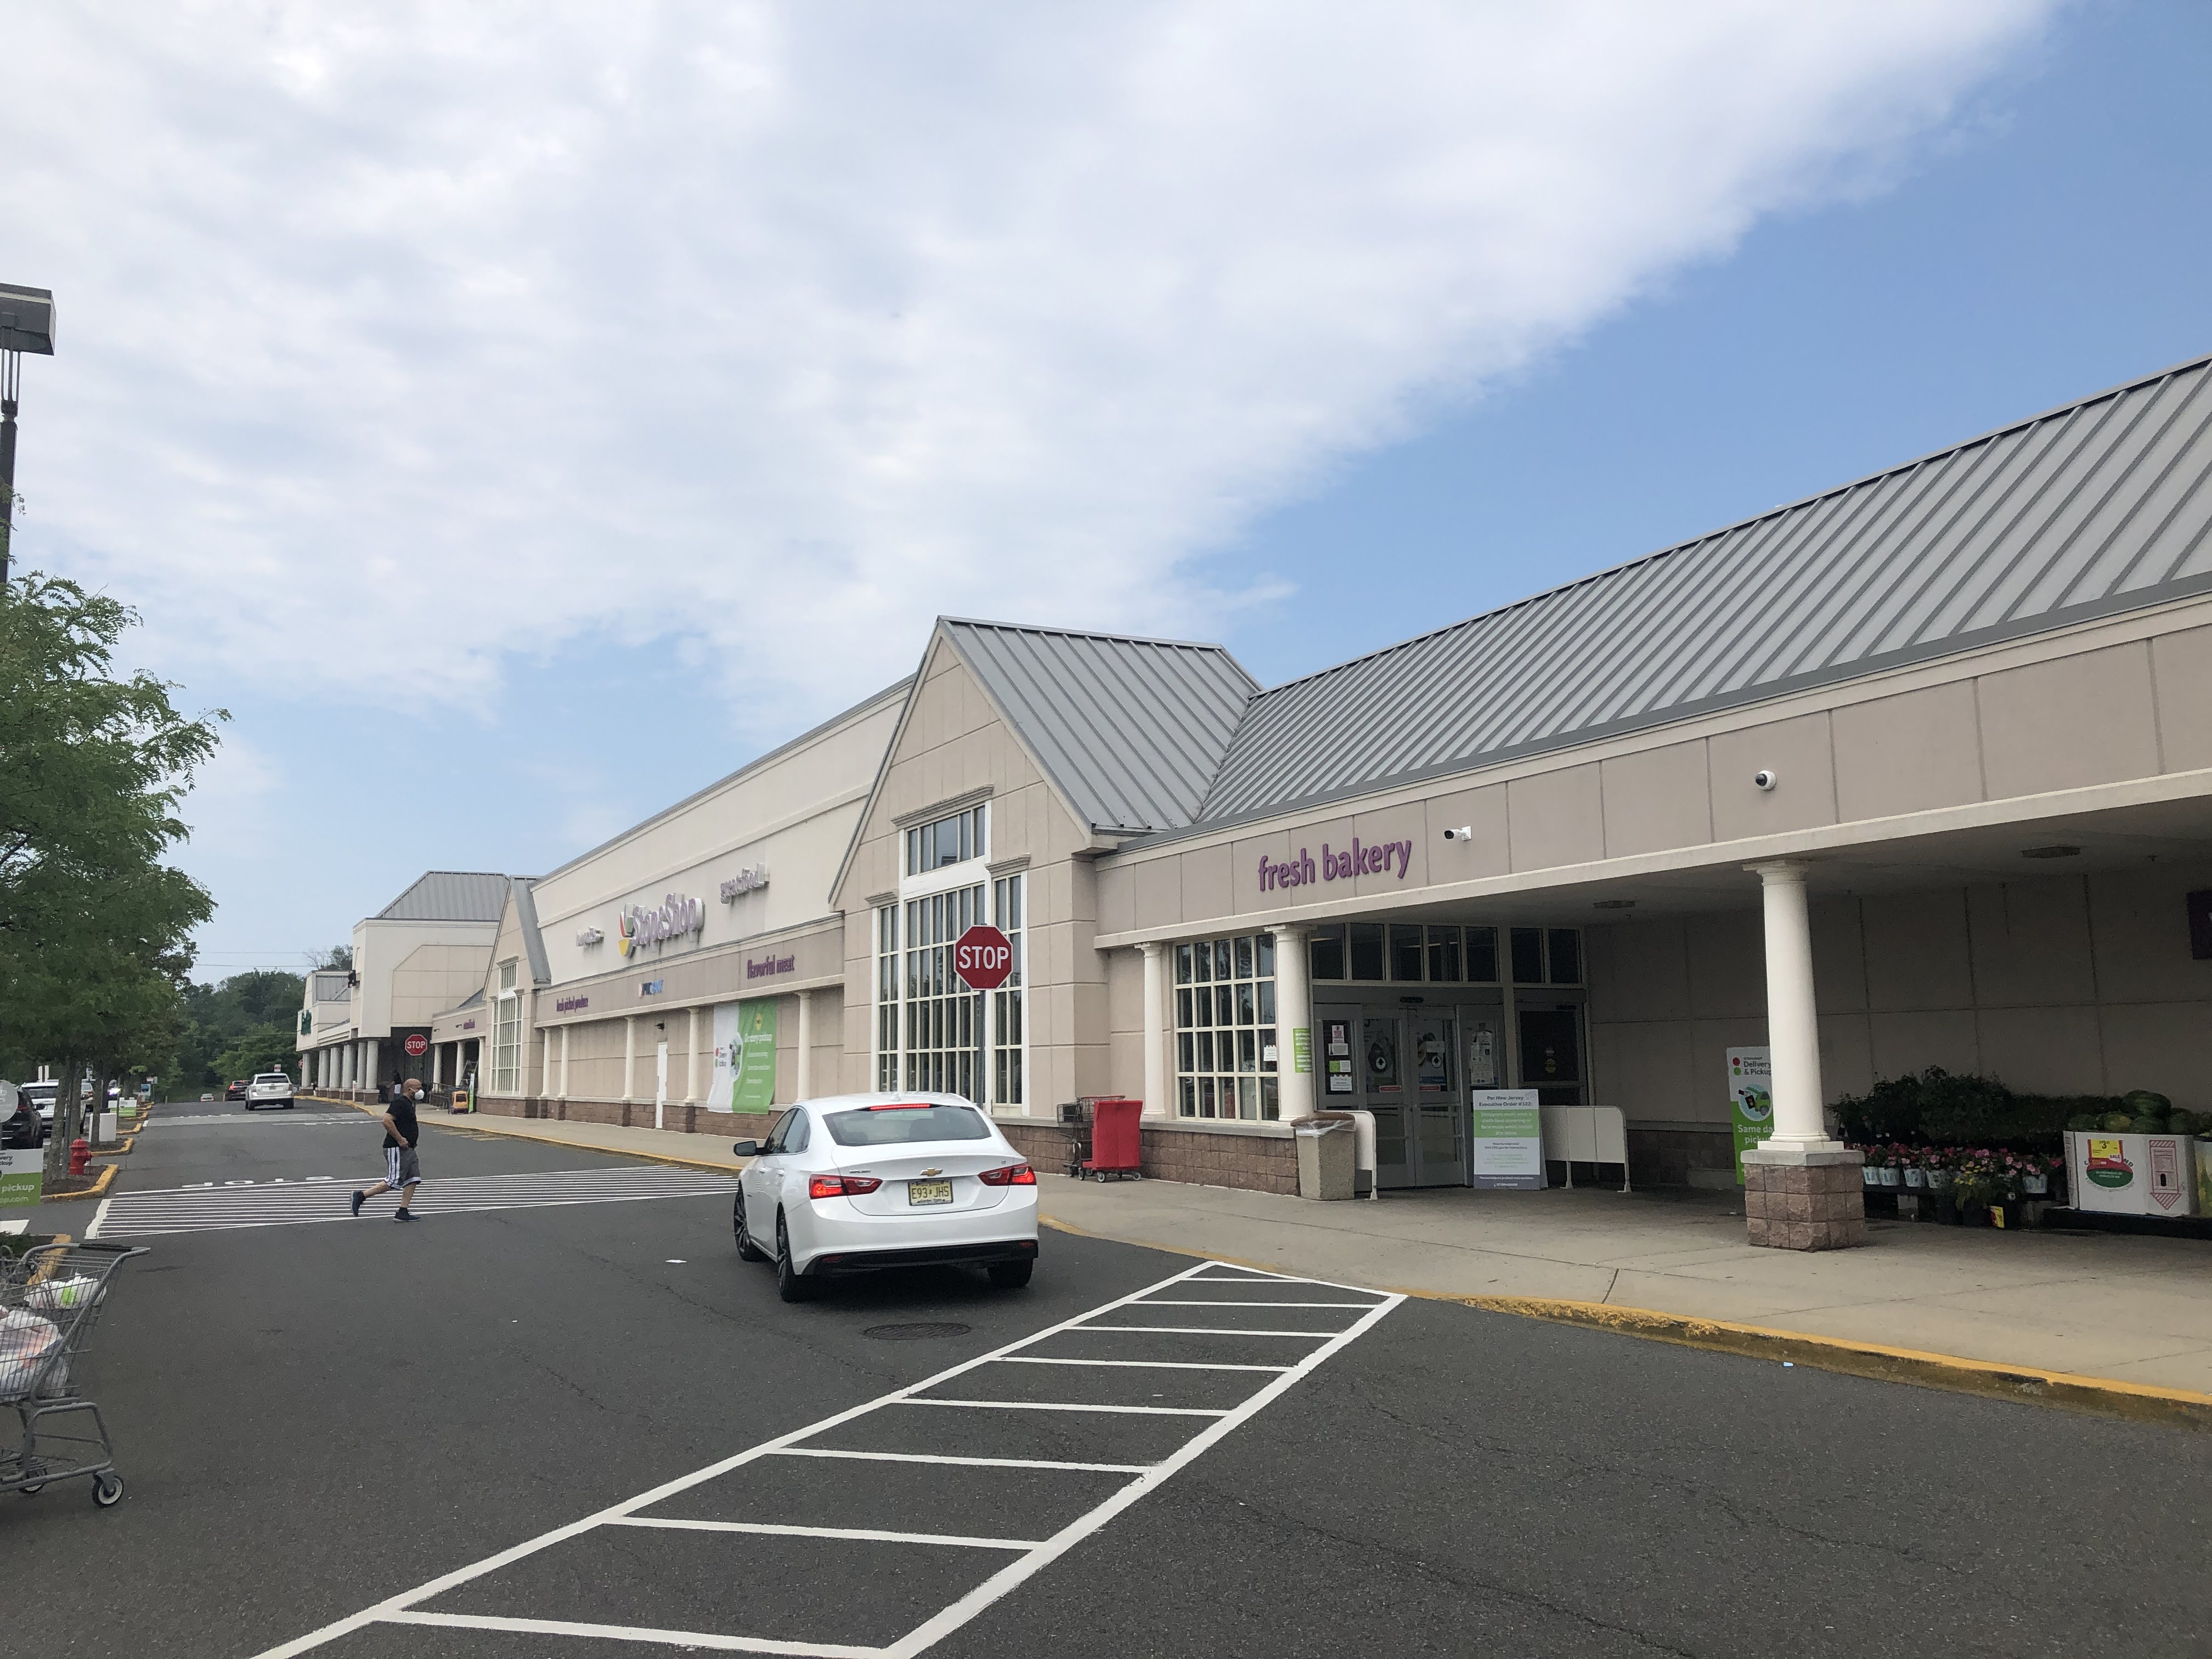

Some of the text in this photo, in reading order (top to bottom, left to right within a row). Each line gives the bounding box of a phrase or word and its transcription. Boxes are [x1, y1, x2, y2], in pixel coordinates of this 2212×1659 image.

[1259, 838, 1412, 891] fresh bakery
[958, 946, 1009, 969] STOP
[747, 954, 795, 979] flavorful meat
[407, 1041, 425, 1049] STOP
[1738, 1125, 1774, 1133] Same da
[1, 1183, 35, 1194] pickup
[911, 1186, 949, 1199] E93 JHS
